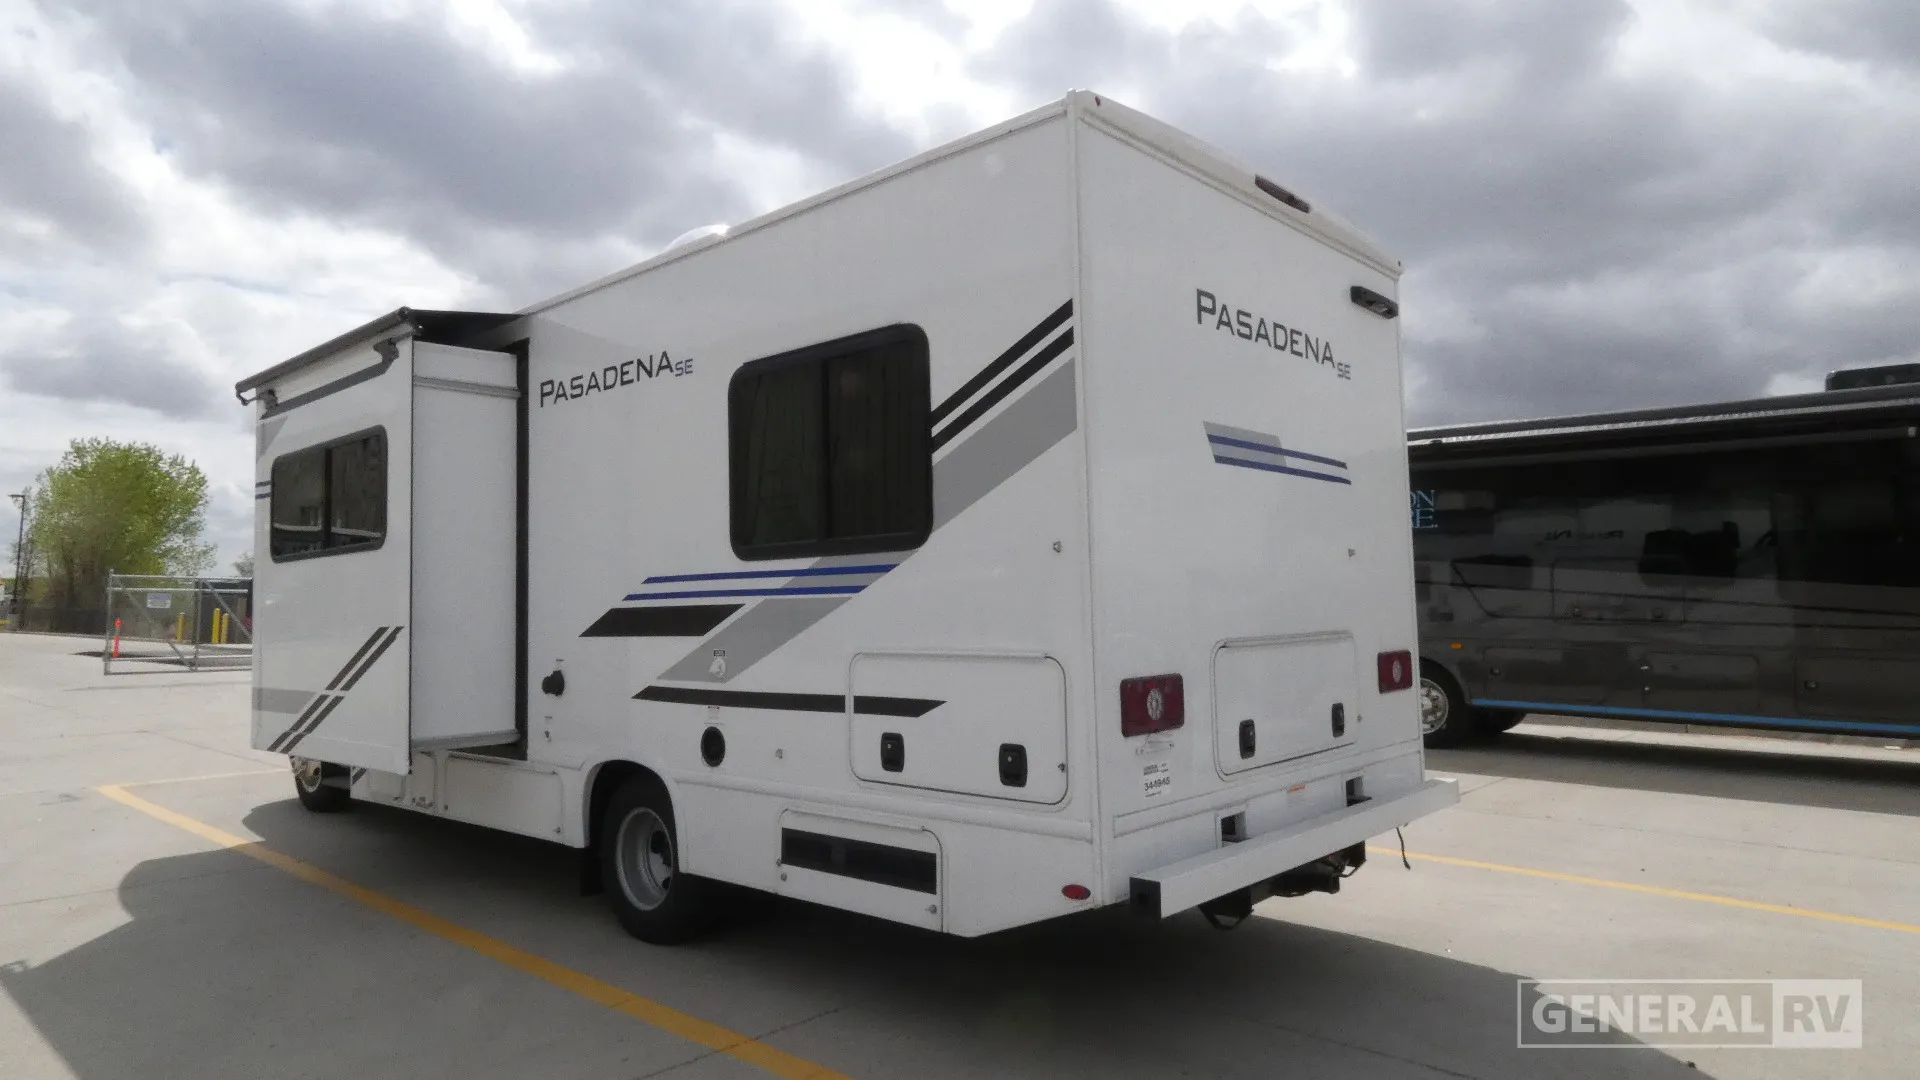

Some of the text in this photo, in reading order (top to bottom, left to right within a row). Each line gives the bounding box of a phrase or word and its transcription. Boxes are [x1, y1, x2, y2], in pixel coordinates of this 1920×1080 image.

[1196, 288, 1351, 381] PASADENA SE
[540, 350, 694, 408] PASADENA SE
